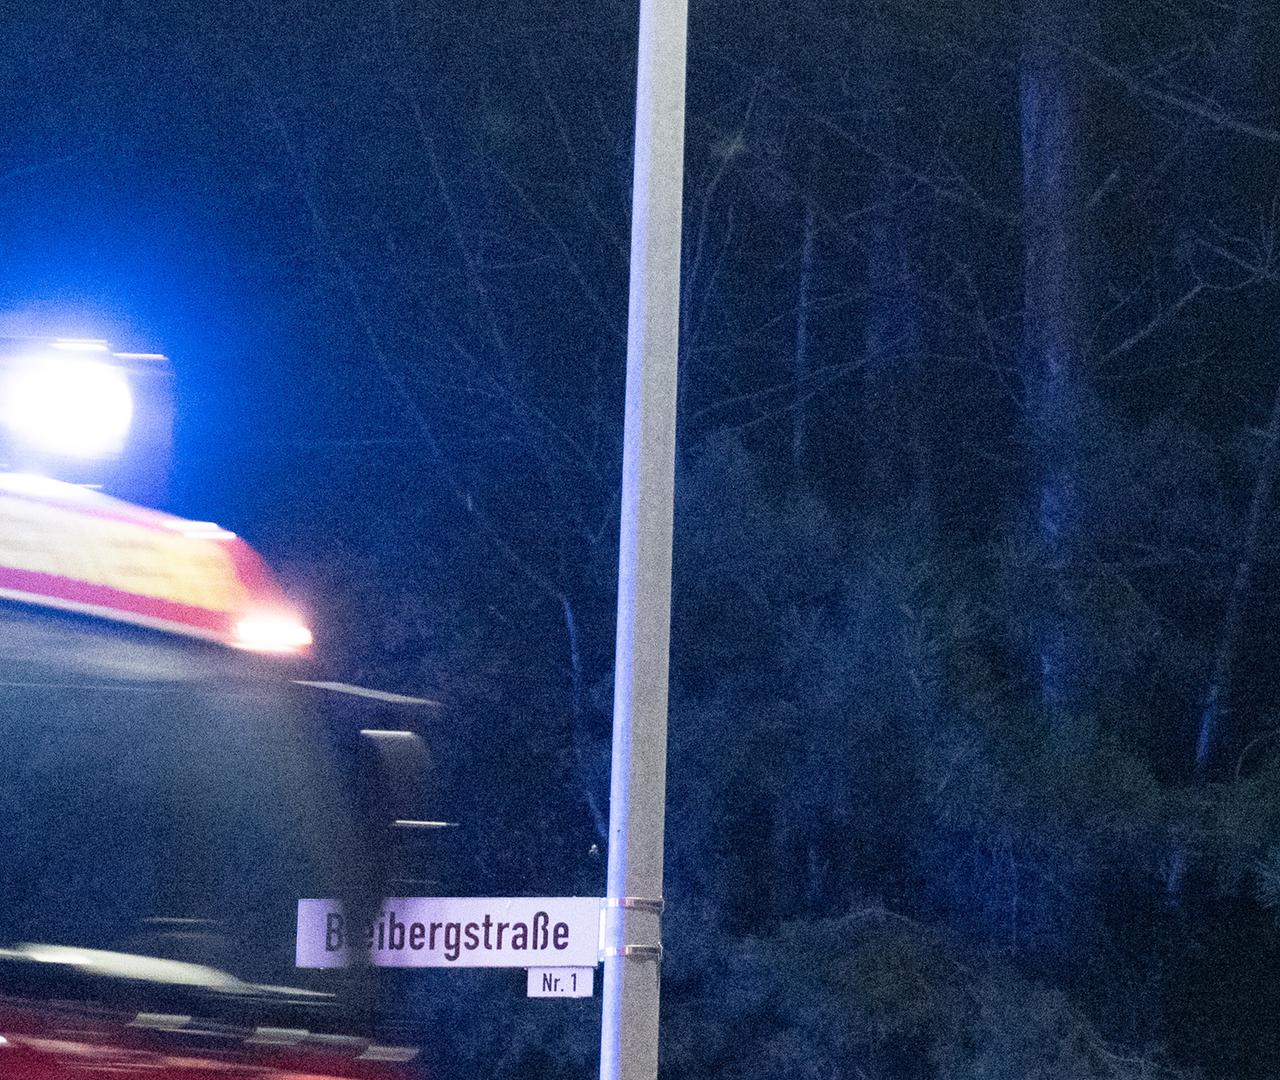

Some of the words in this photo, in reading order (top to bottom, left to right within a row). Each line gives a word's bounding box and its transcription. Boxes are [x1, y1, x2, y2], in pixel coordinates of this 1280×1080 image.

[325, 911, 569, 962] Beibergstraße
[542, 973, 564, 992] Nr.
[570, 973, 577, 992] 1
